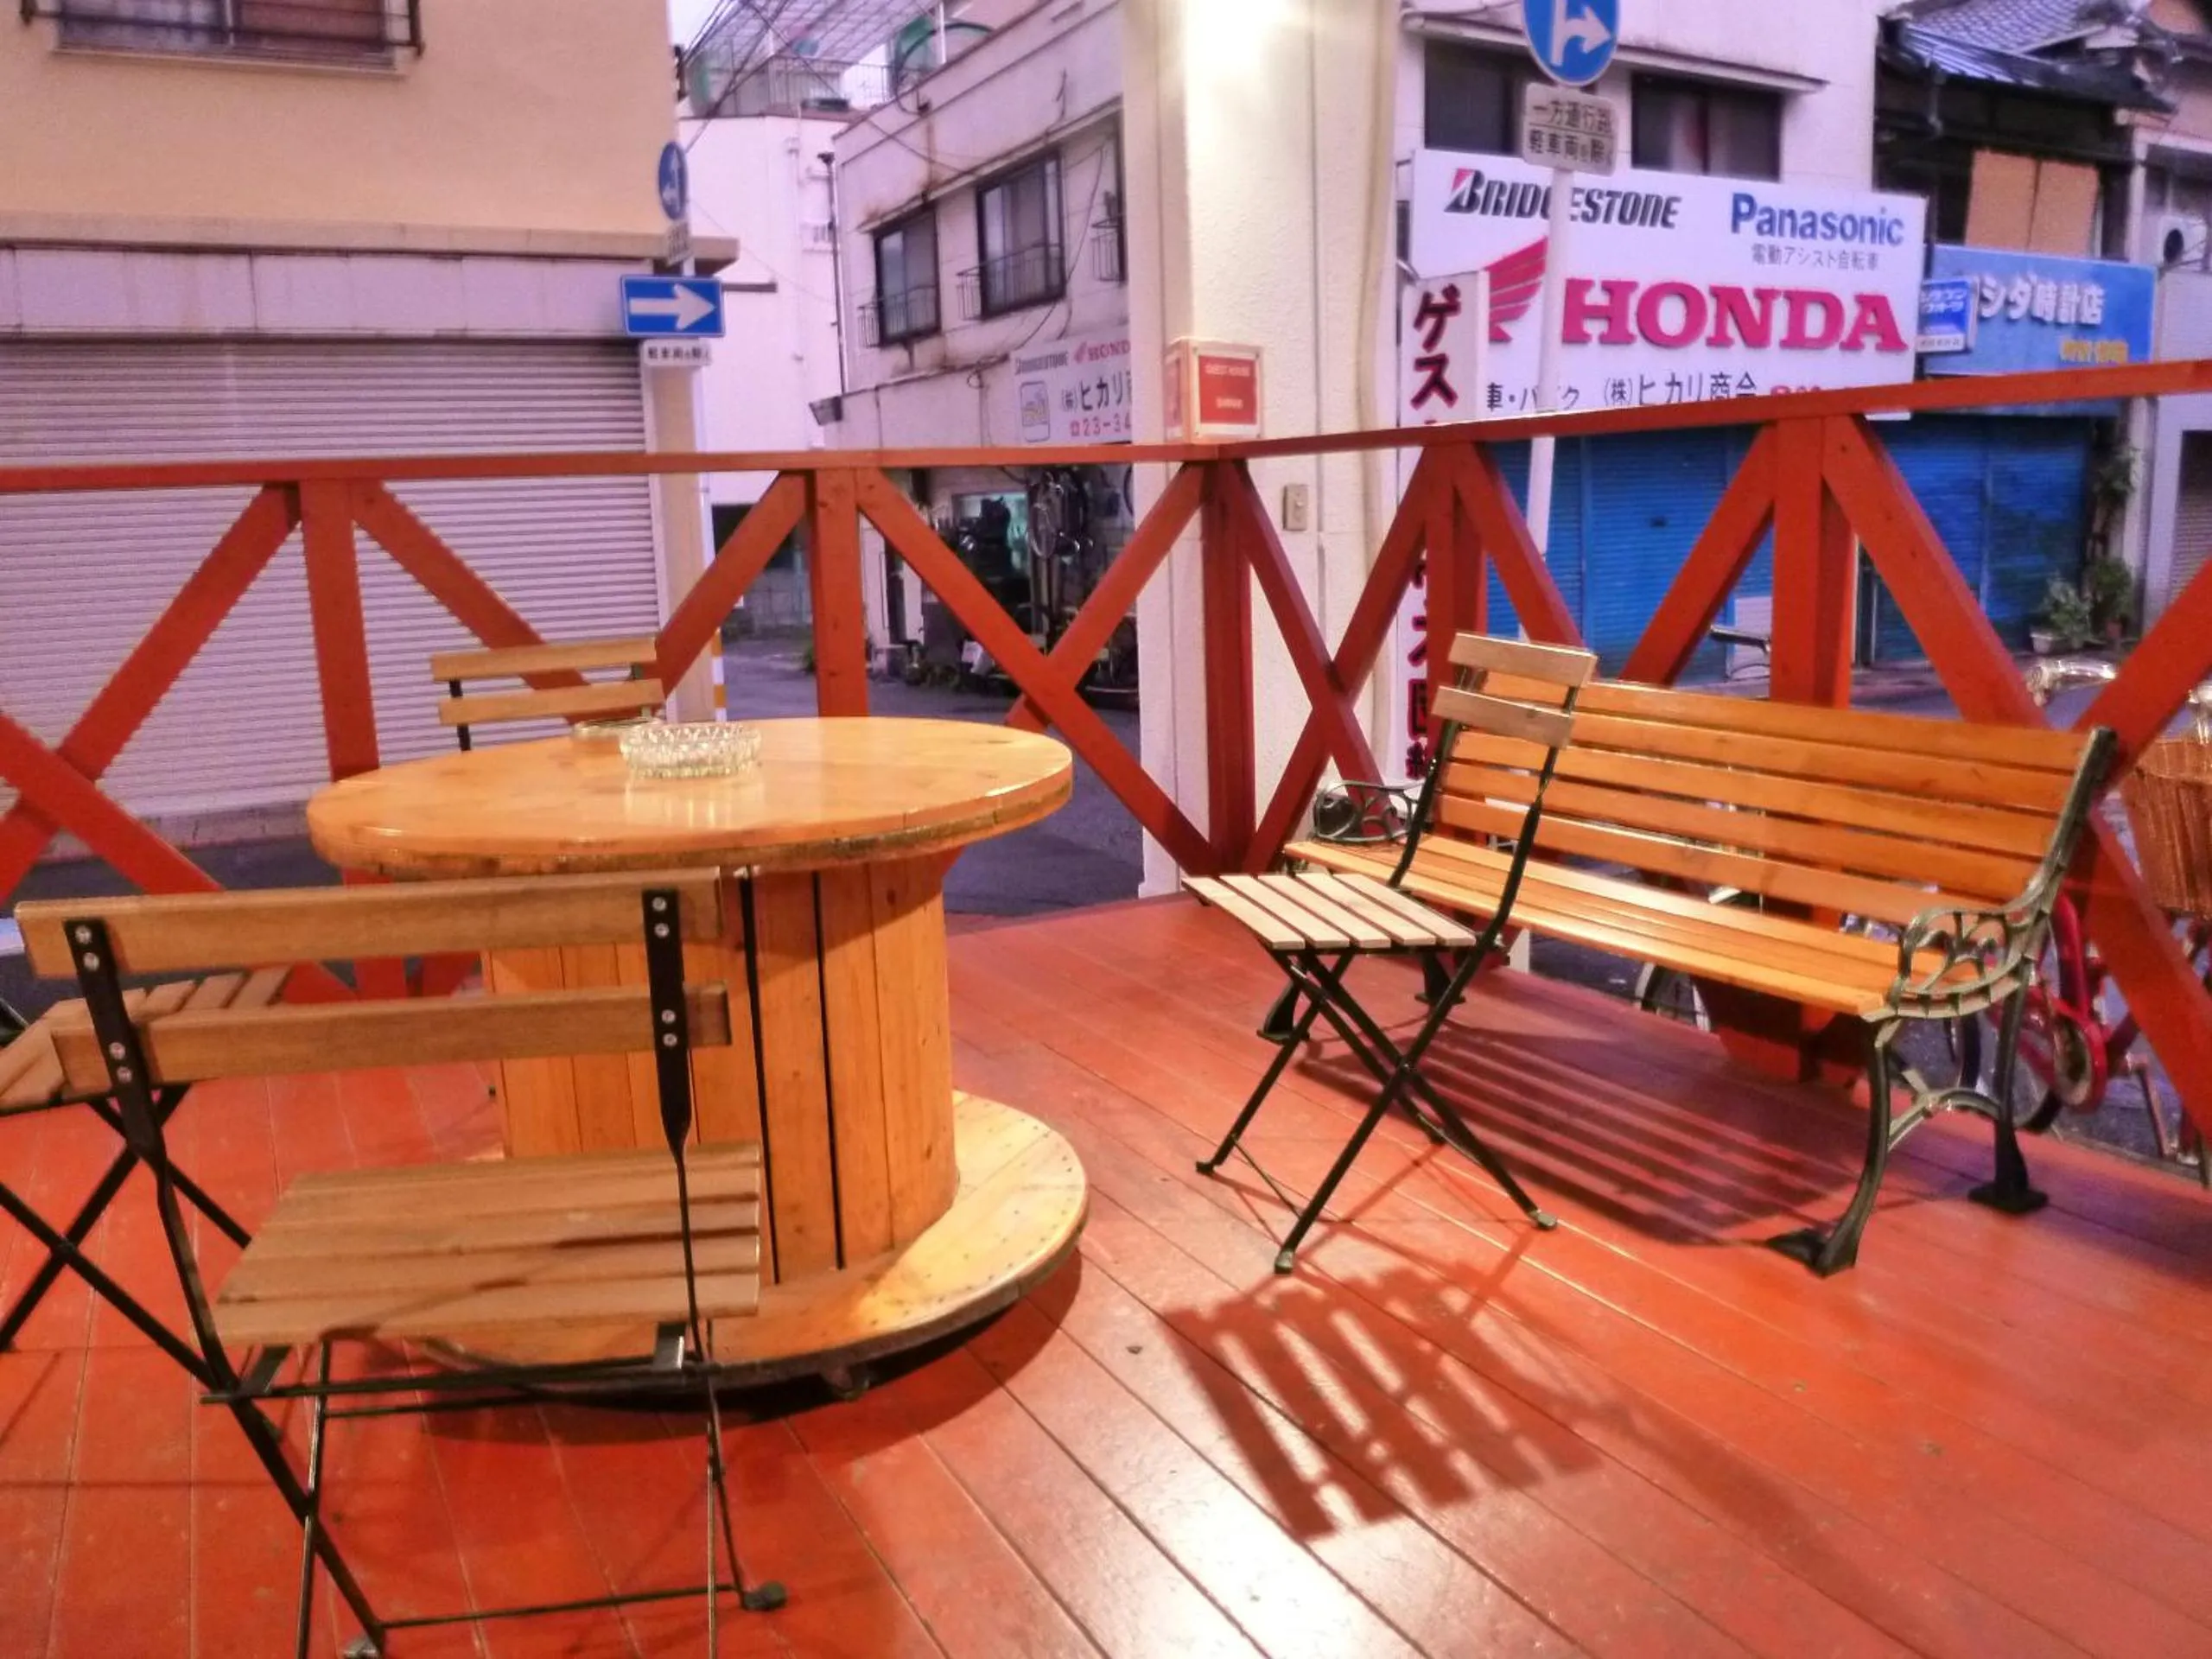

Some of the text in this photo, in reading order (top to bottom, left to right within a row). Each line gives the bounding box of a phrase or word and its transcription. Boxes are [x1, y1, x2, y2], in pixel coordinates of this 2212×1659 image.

[1731, 192, 1905, 247] Panasonic
[1751, 242, 1879, 271] 電動アシスト自転車
[1562, 277, 1910, 353] HONDA
[1088, 340, 1130, 361] HOND
[1409, 283, 1461, 424] ゲス
